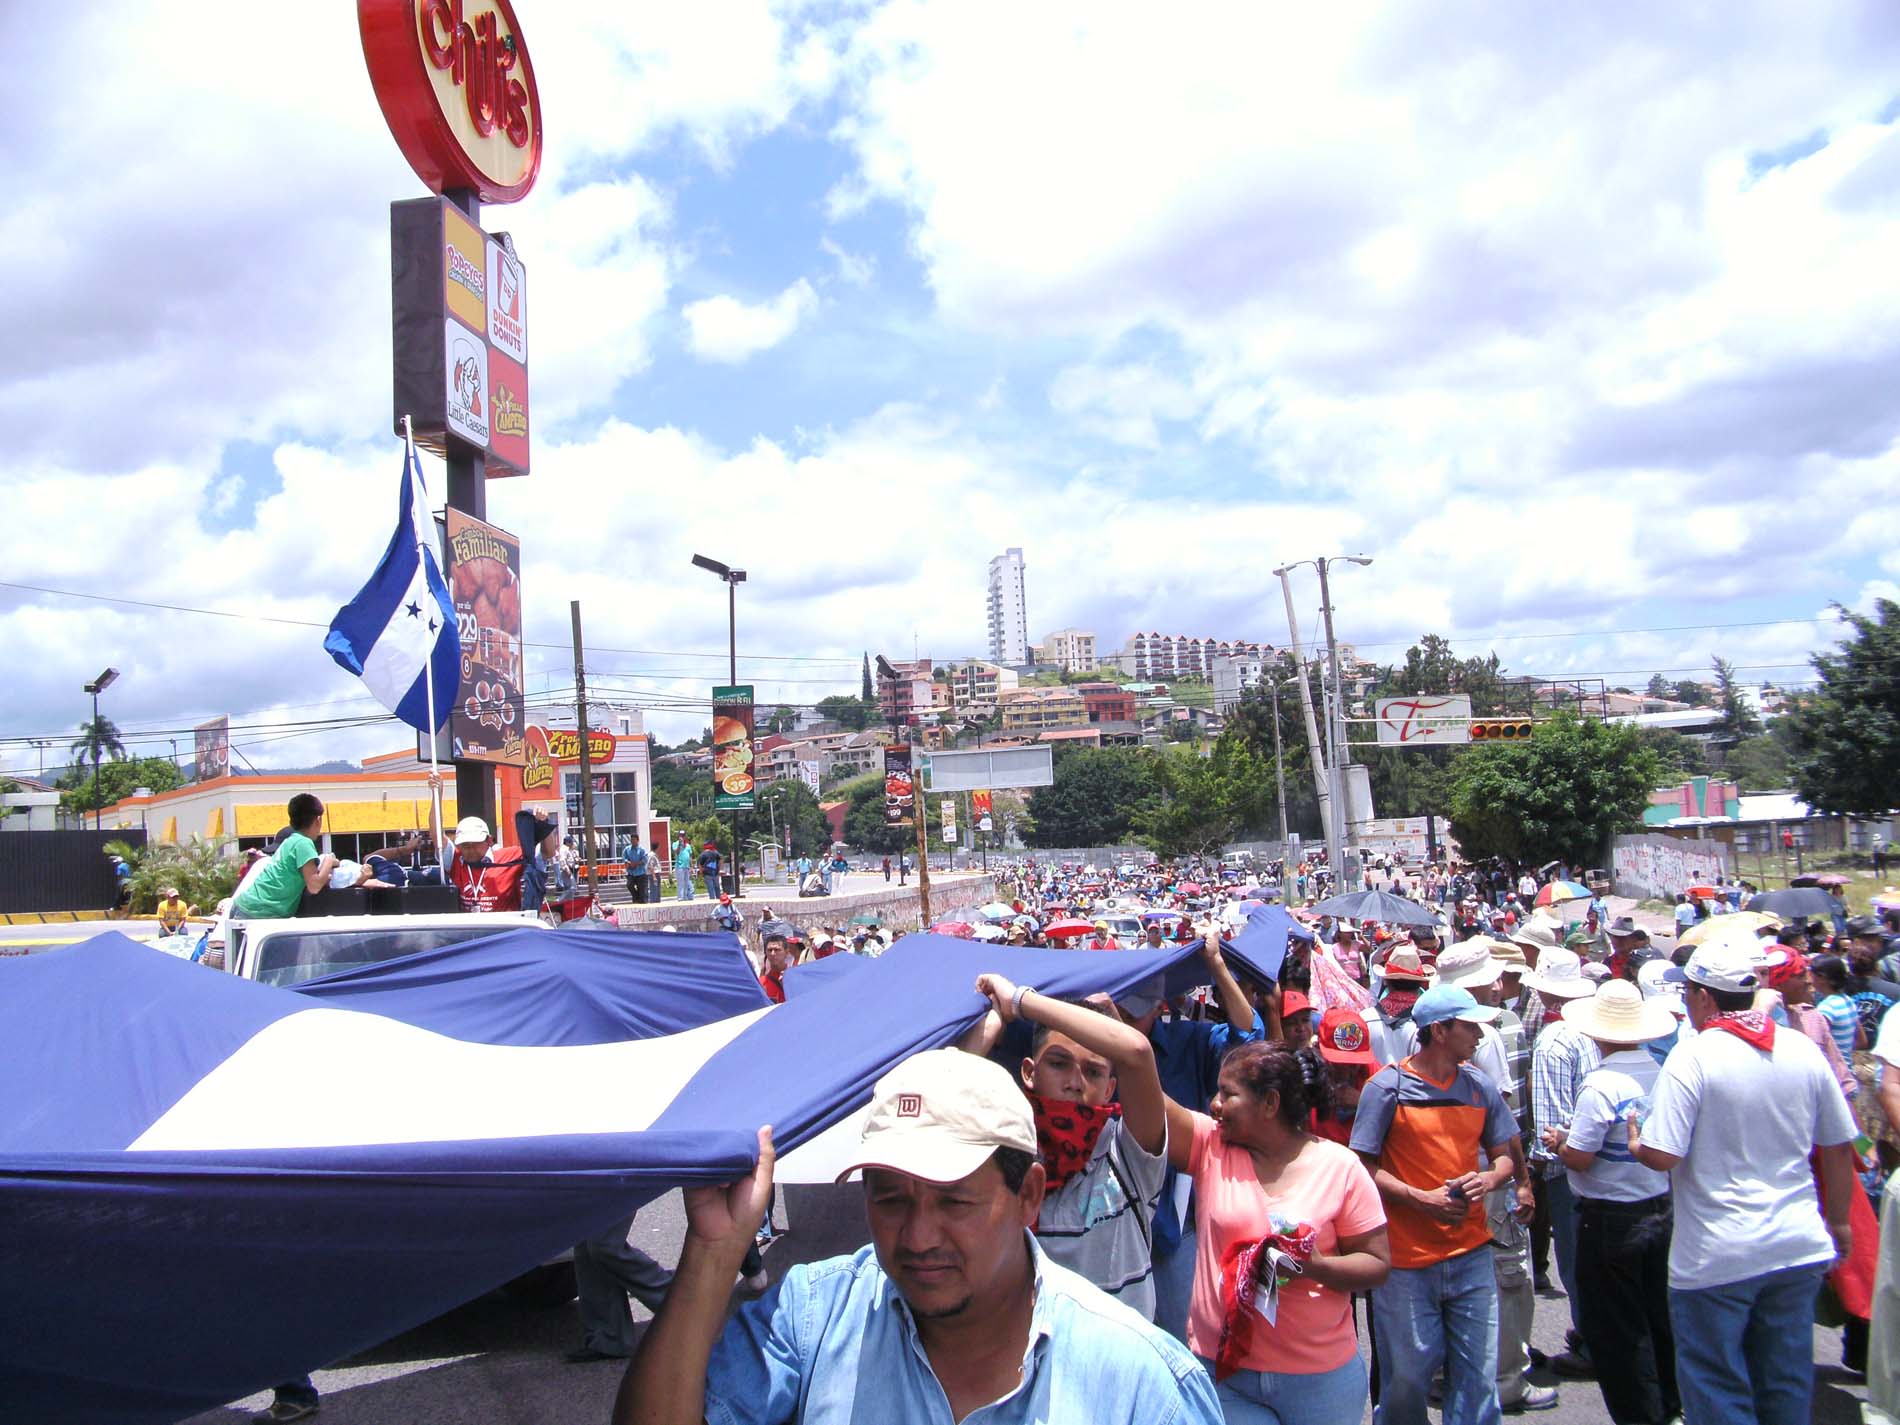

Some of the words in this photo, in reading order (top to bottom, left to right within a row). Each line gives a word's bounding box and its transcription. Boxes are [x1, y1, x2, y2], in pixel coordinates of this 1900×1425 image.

[493, 323, 522, 352] DONUTS
[448, 401, 465, 425] Little
[465, 412, 488, 439] Caesars
[452, 527, 508, 567] Familiar
[464, 659, 470, 673] 8
[549, 739, 612, 757] CAMERO
